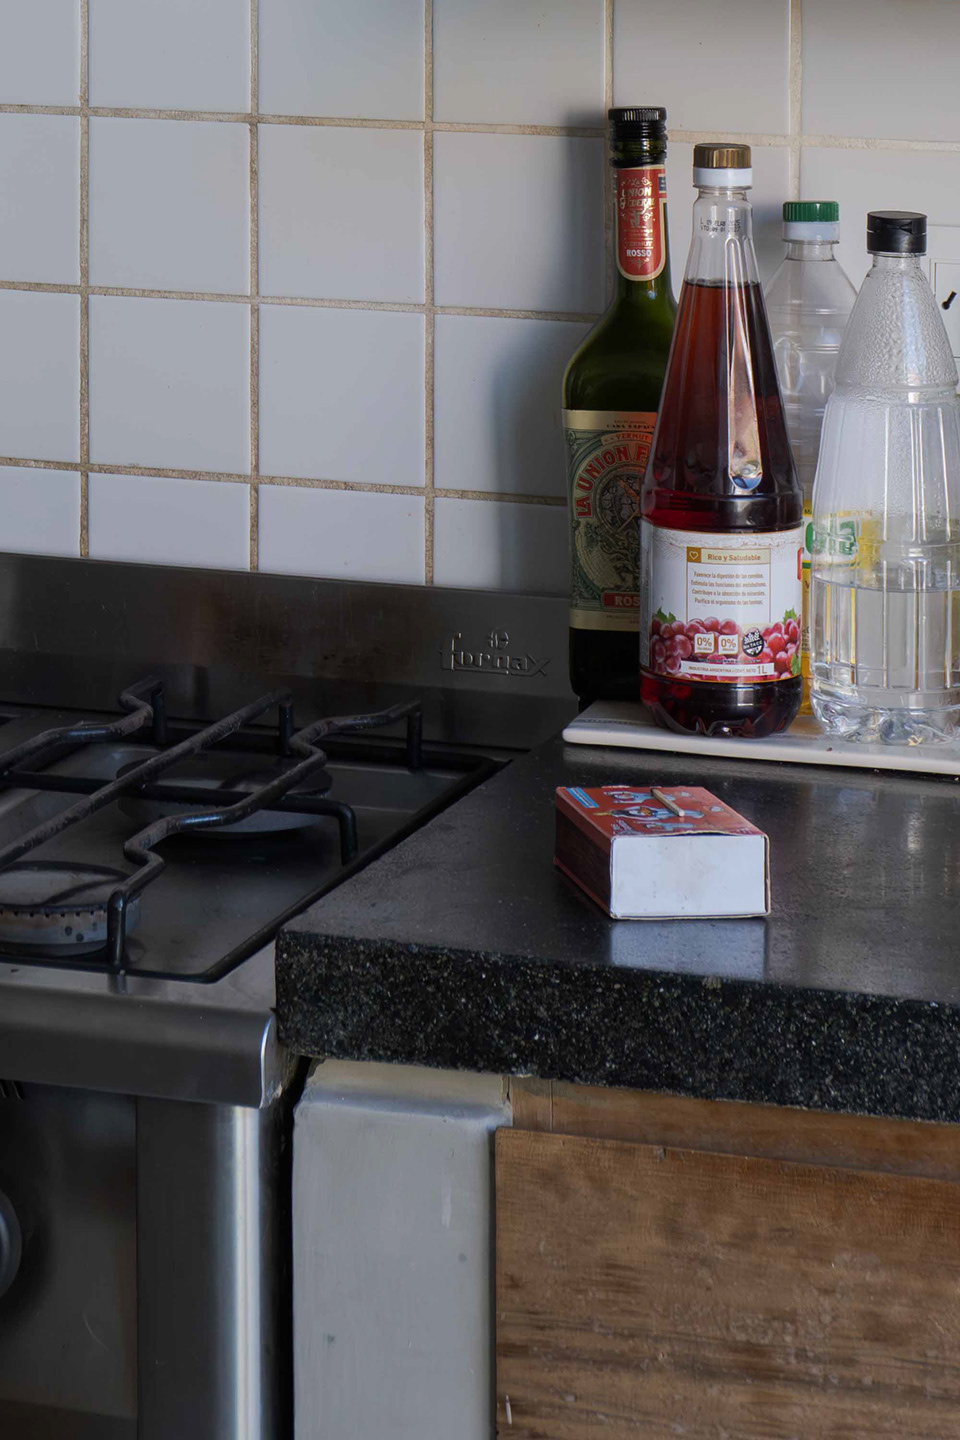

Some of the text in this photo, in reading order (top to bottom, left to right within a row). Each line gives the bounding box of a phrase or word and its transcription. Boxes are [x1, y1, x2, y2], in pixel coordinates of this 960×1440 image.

[626, 249, 652, 257] ROSSO
[616, 432, 649, 441] VERMUT
[578, 445, 630, 491] UNION
[707, 553, 722, 561] Rico
[728, 553, 761, 561] Saludable
[614, 595, 641, 607] ROS
[696, 636, 713, 647] 0%
[720, 637, 737, 648] 0%
